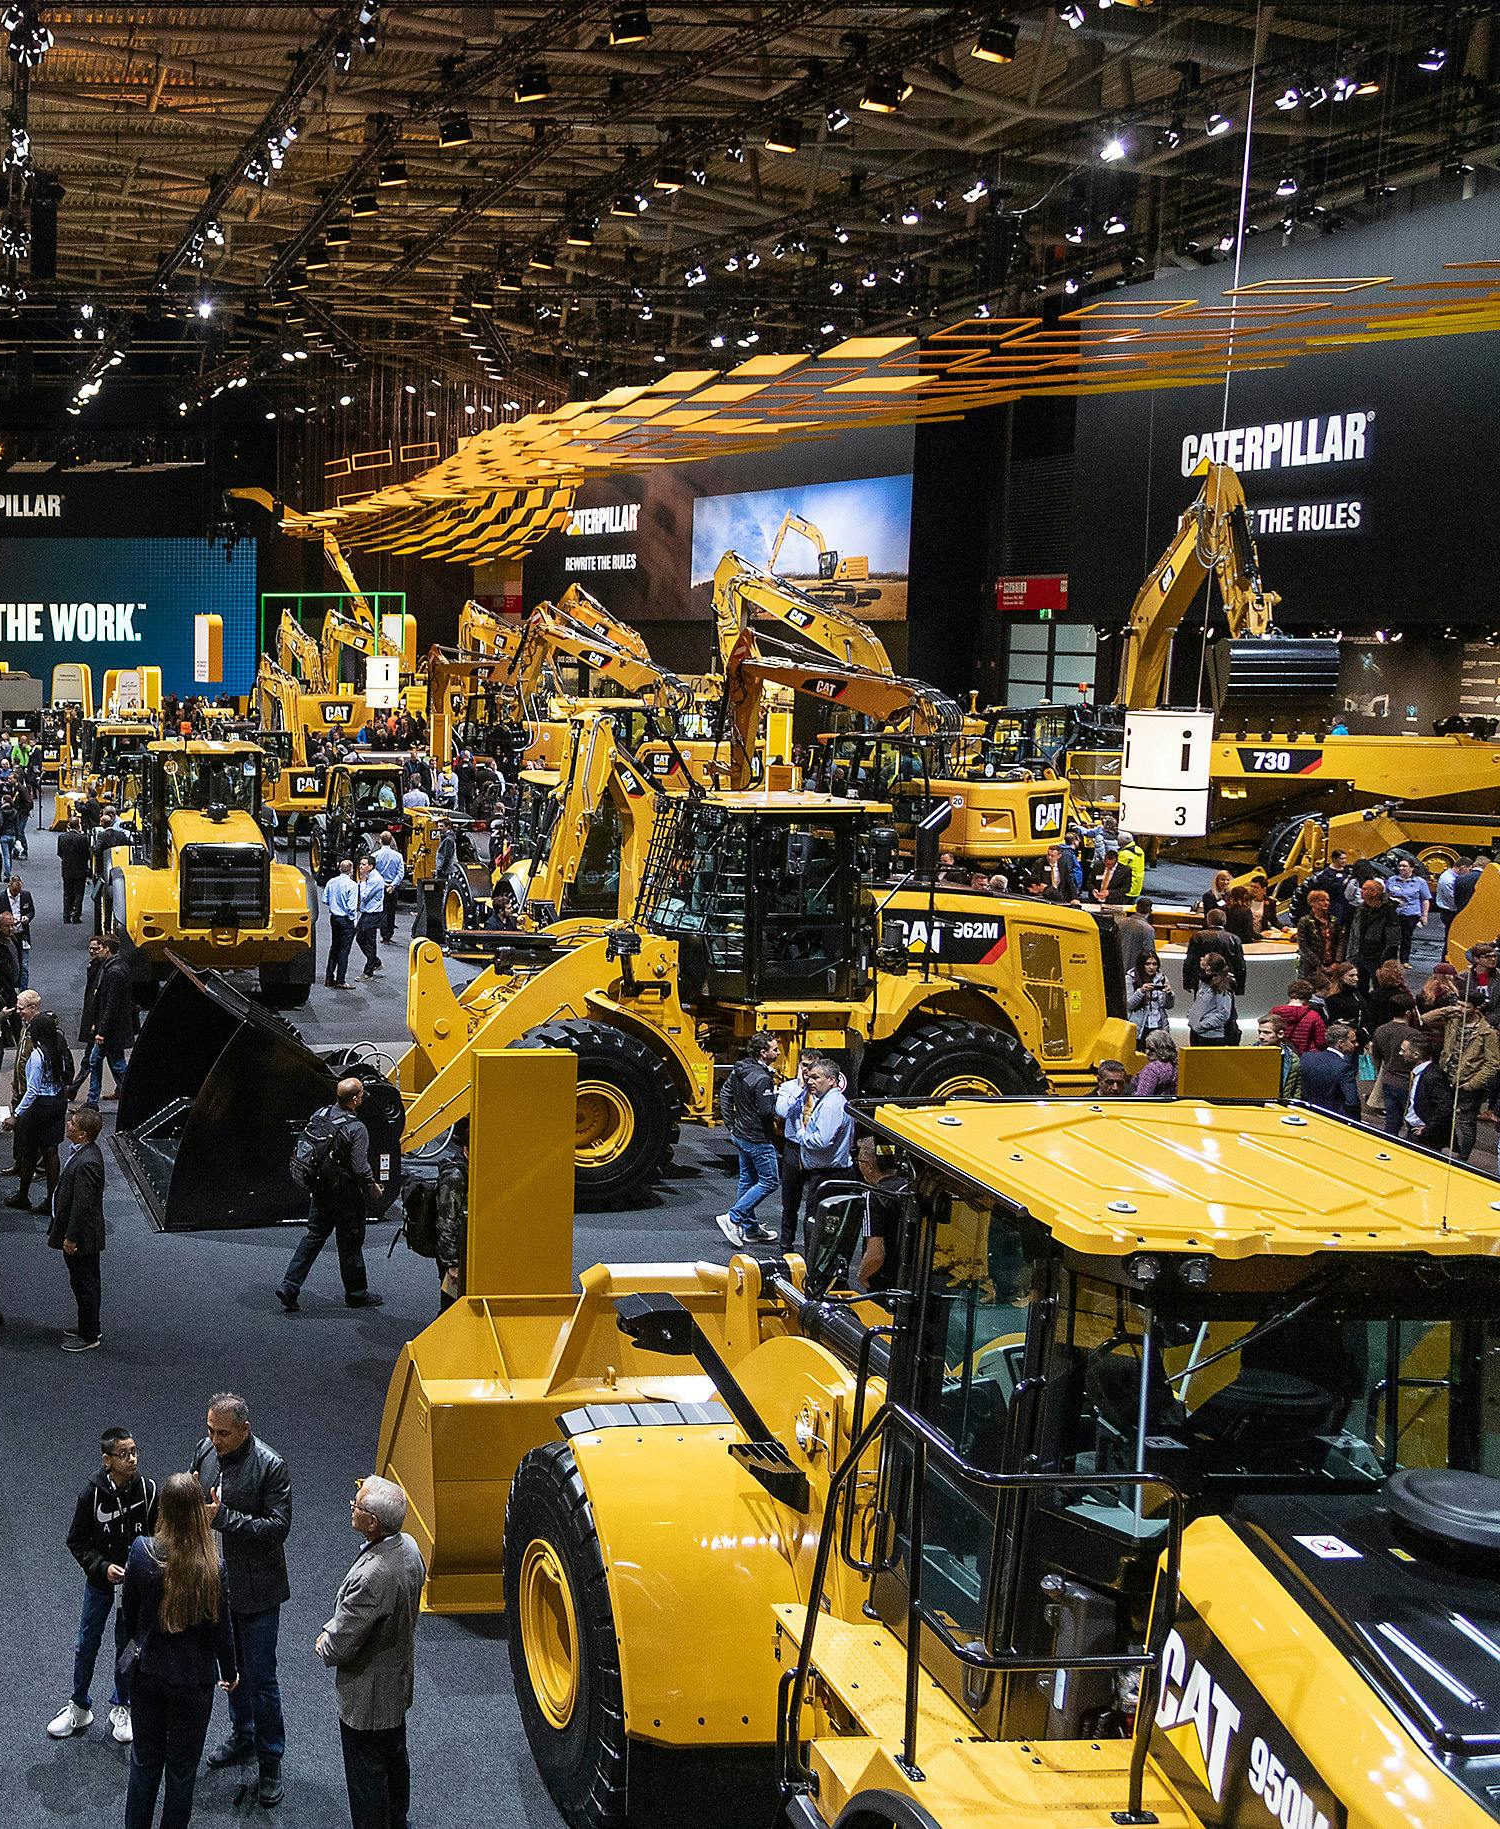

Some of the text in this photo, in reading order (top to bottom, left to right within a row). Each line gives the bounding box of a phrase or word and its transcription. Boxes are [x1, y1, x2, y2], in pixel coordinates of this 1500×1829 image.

[1257, 506, 1293, 534] THE
[1297, 501, 1361, 532] RULES
[565, 553, 637, 571] REWRITE THE RULES
[789, 608, 808, 627] CAT
[588, 651, 605, 668] CAT
[477, 668, 489, 678] CAT
[816, 680, 836, 697] CAT
[383, 695, 389, 704] 2
[325, 705, 349, 722] CAT
[43, 749, 58, 759] CAT
[653, 754, 670, 766] CAT
[1252, 751, 1291, 771] 730
[297, 776, 320, 793] CAT
[621, 769, 637, 792] CAT
[1035, 802, 1062, 832] CAT
[1174, 806, 1187, 826] 3
[953, 921, 999, 939] 962M
[1155, 1628, 1241, 1803] CAT
